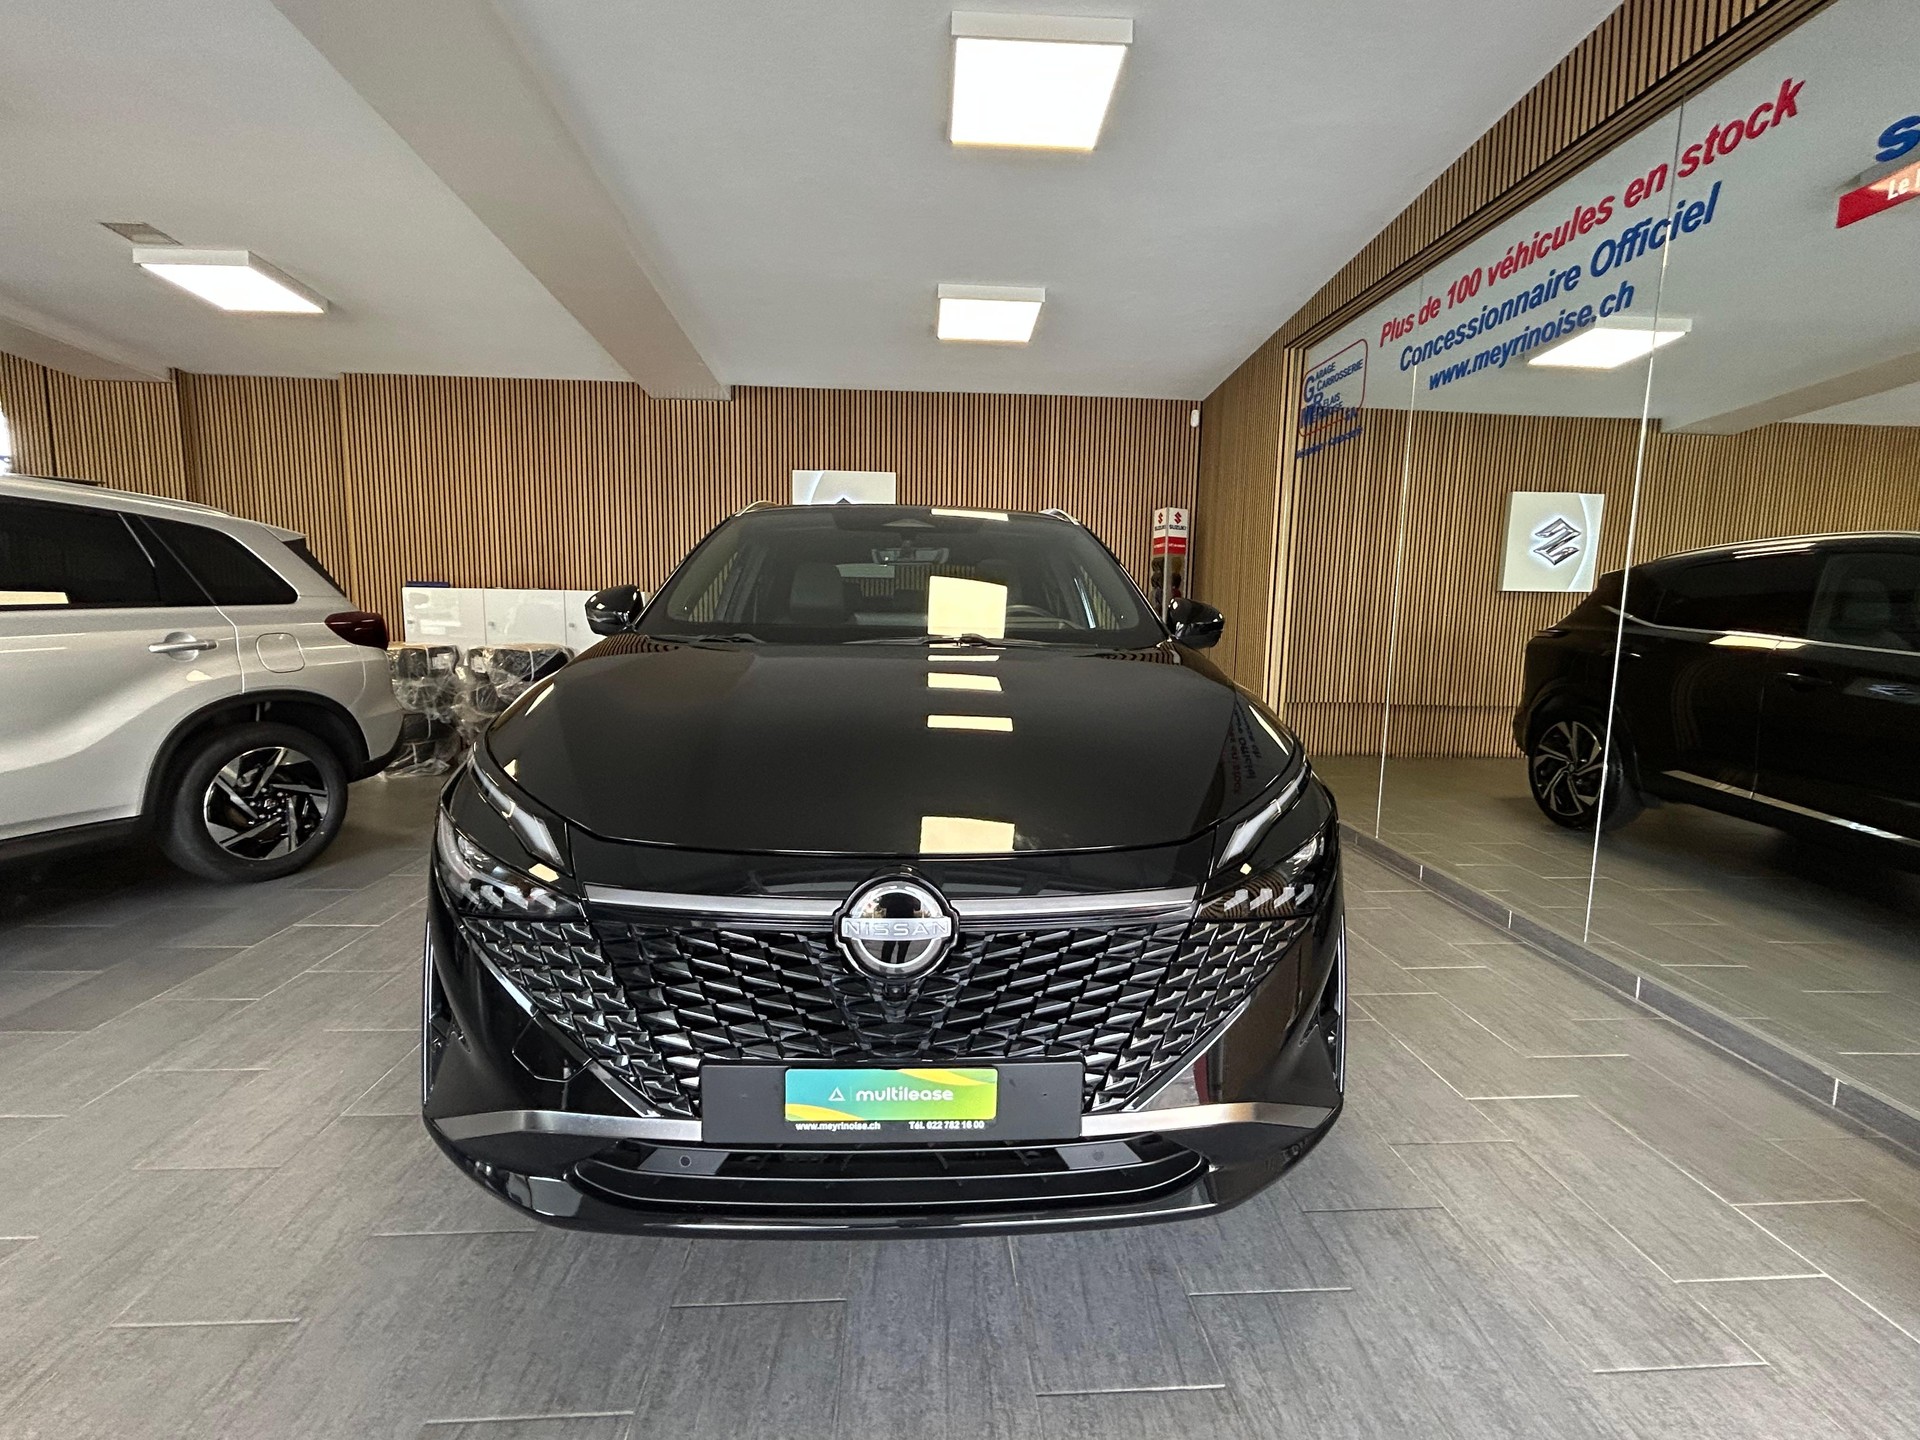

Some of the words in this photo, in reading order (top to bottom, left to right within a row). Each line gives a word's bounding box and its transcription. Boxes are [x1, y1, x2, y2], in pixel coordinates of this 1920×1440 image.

[1886, 178, 1911, 201] Le
[1380, 314, 1415, 348] Plus
[1418, 296, 1441, 325] de
[1447, 267, 1482, 310] 100
[1487, 195, 1616, 287] véhicules
[1624, 163, 1668, 208] en
[1677, 77, 1806, 178] stock
[1399, 264, 1582, 372] Concessionnaire
[1590, 180, 1722, 278] Officiel
[1428, 280, 1635, 391] www.meyrinoise.ch
[1316, 359, 1364, 391] CARROSSERIE
[844, 921, 949, 936] NISSAN
[855, 1086, 954, 1102] multilease
[795, 1121, 882, 1132] www.meyrinoise.ch
[926, 1120, 943, 1130] 022
[973, 1120, 985, 1130] 00
